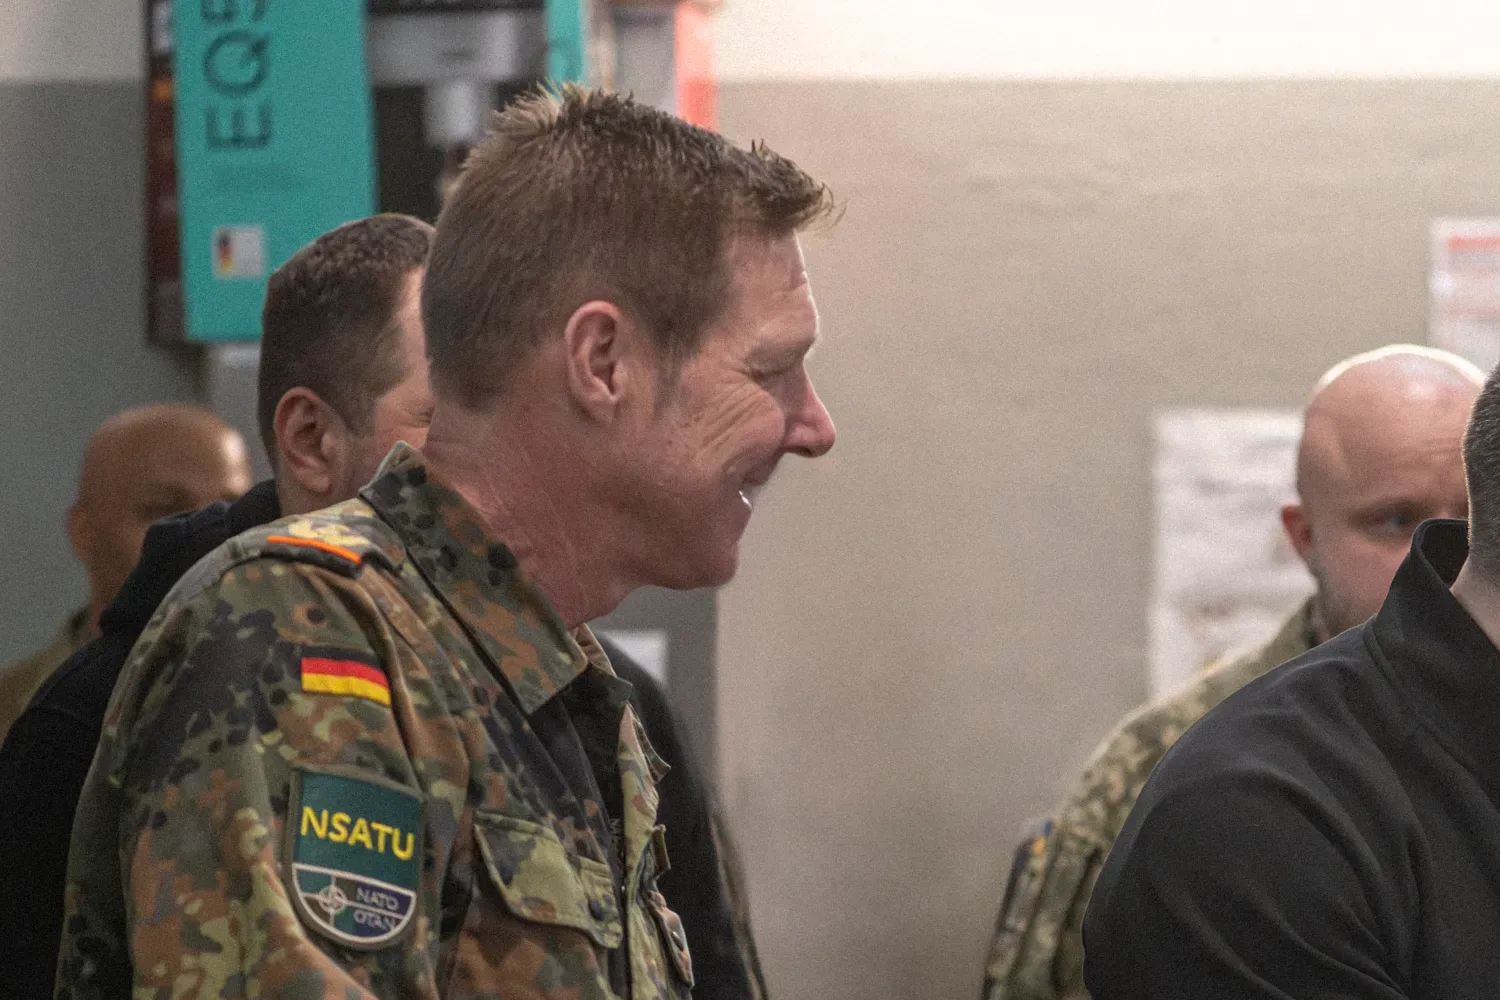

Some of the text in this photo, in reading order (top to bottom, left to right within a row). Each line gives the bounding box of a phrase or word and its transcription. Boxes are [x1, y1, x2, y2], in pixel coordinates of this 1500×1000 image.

[301, 806, 415, 861] NSATU
[356, 887, 399, 911] NATO
[354, 908, 396, 932] OTAN
